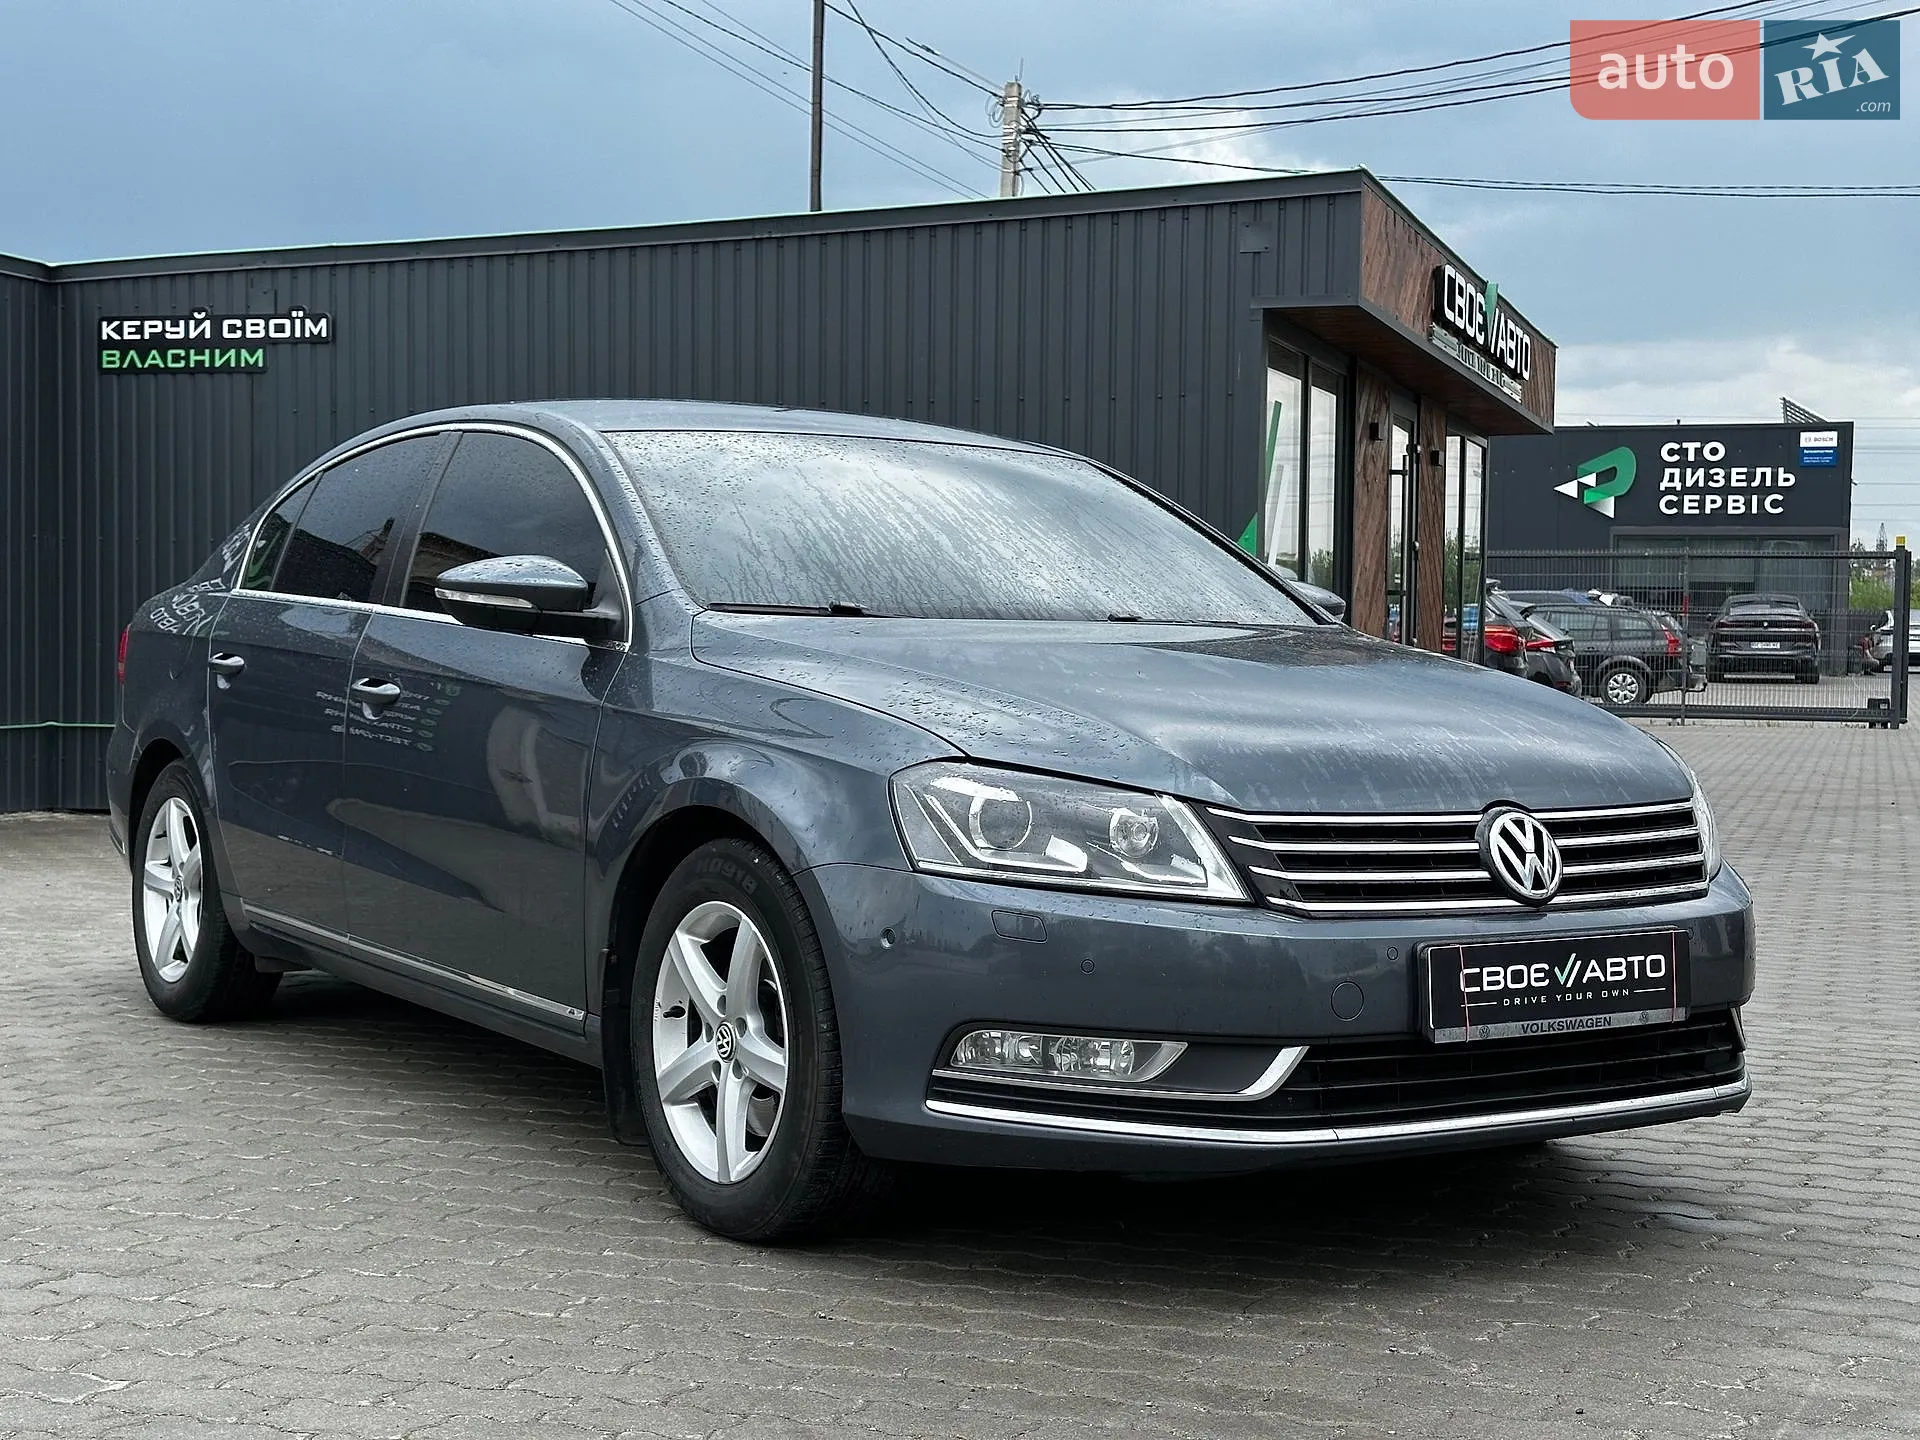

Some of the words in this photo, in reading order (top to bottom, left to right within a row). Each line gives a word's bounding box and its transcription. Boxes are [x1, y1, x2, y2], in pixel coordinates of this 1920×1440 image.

[101, 312, 211, 340] КЕРУЙ
[222, 310, 328, 339] СВОЇМ
[1496, 312, 1531, 381] АВТО
[102, 348, 264, 369] ВЛАСНИМ
[1660, 441, 1726, 462] СТО
[1659, 467, 1796, 491] ДИЗЕЛЬ
[1659, 493, 1784, 515] СЕРВІС
[1582, 954, 1666, 984] АВТО
[1503, 994, 1547, 1007] DRIVE
[1556, 991, 1593, 1002] YOUR
[1601, 988, 1629, 998] OWN
[1521, 1016, 1612, 1035] VOLKSWAGEN
